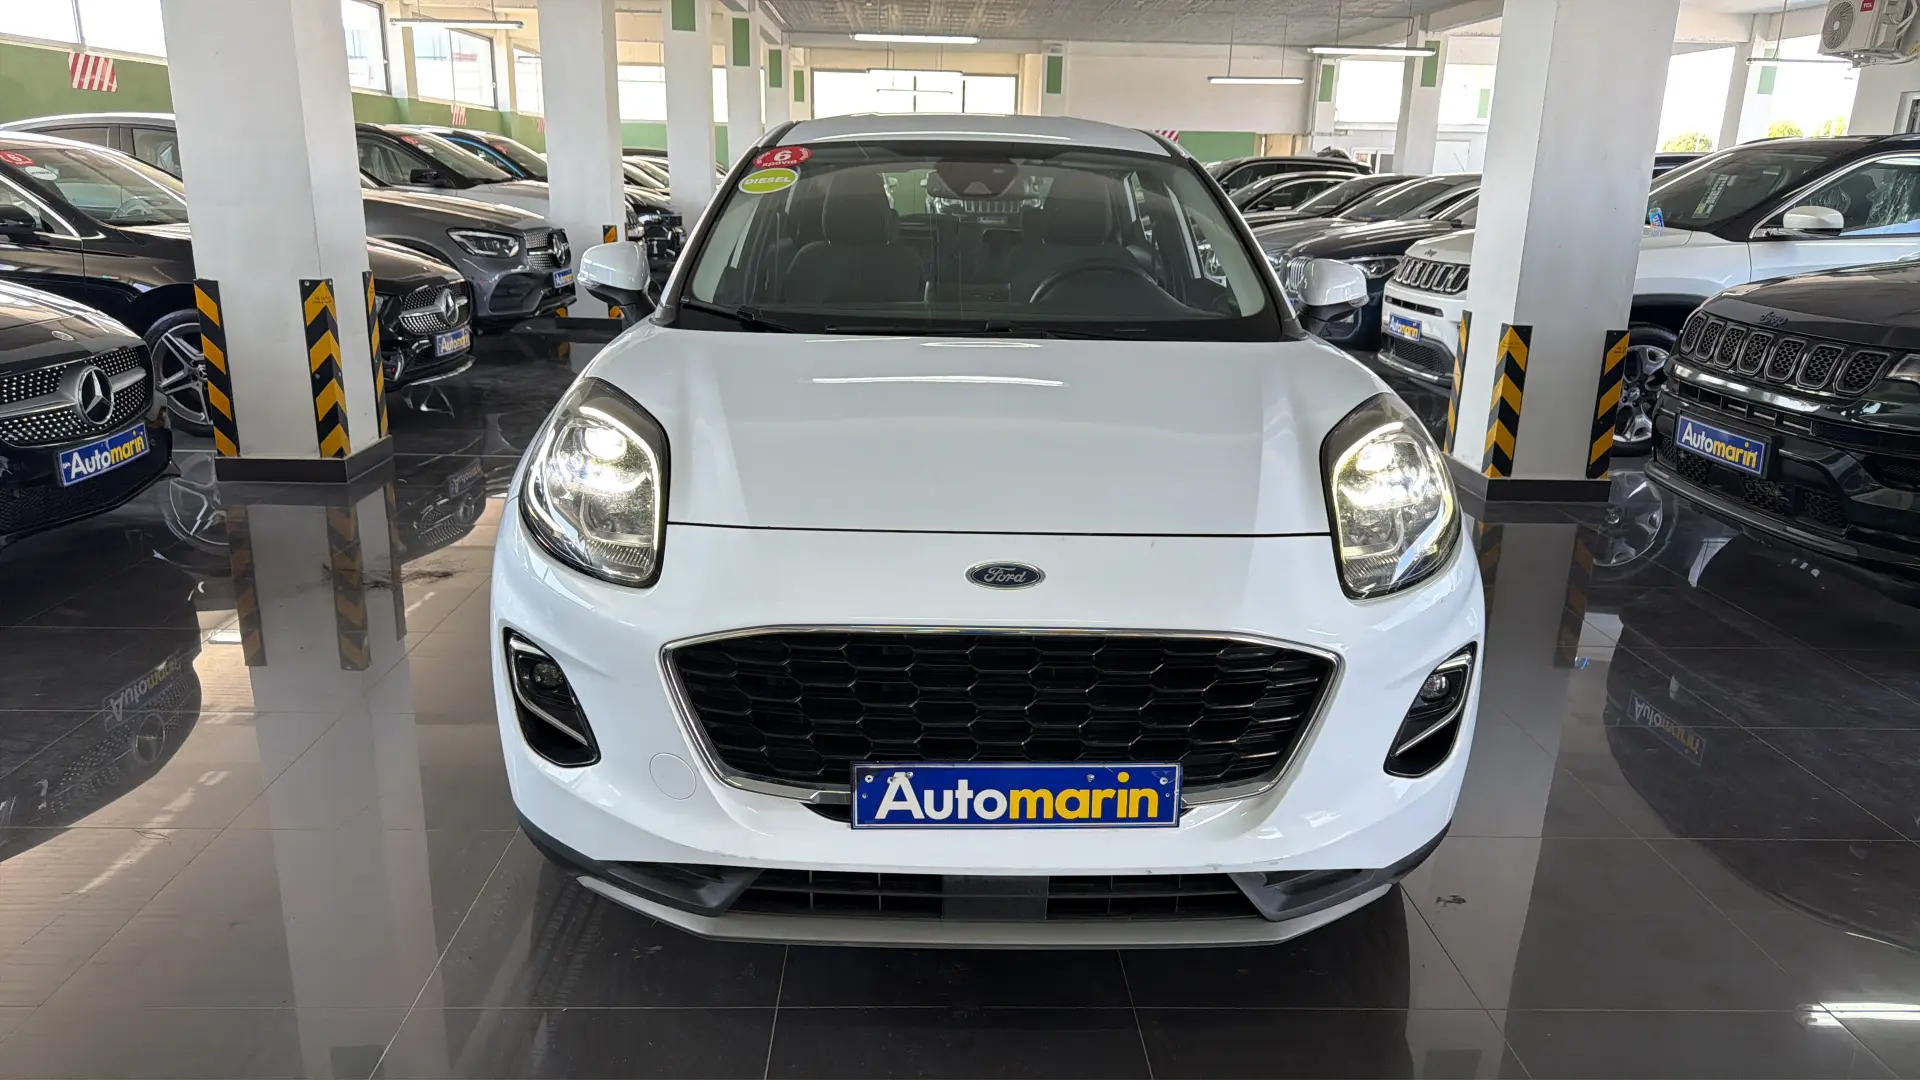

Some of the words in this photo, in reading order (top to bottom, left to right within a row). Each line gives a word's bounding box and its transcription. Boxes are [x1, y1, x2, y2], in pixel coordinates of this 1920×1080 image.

[774, 149, 792, 161] 6
[744, 176, 791, 185] DIESEL
[71, 430, 145, 479] Automarin
[1681, 421, 1758, 468] Automarin
[983, 566, 1027, 583] Ford
[874, 771, 1159, 820] Automarin
